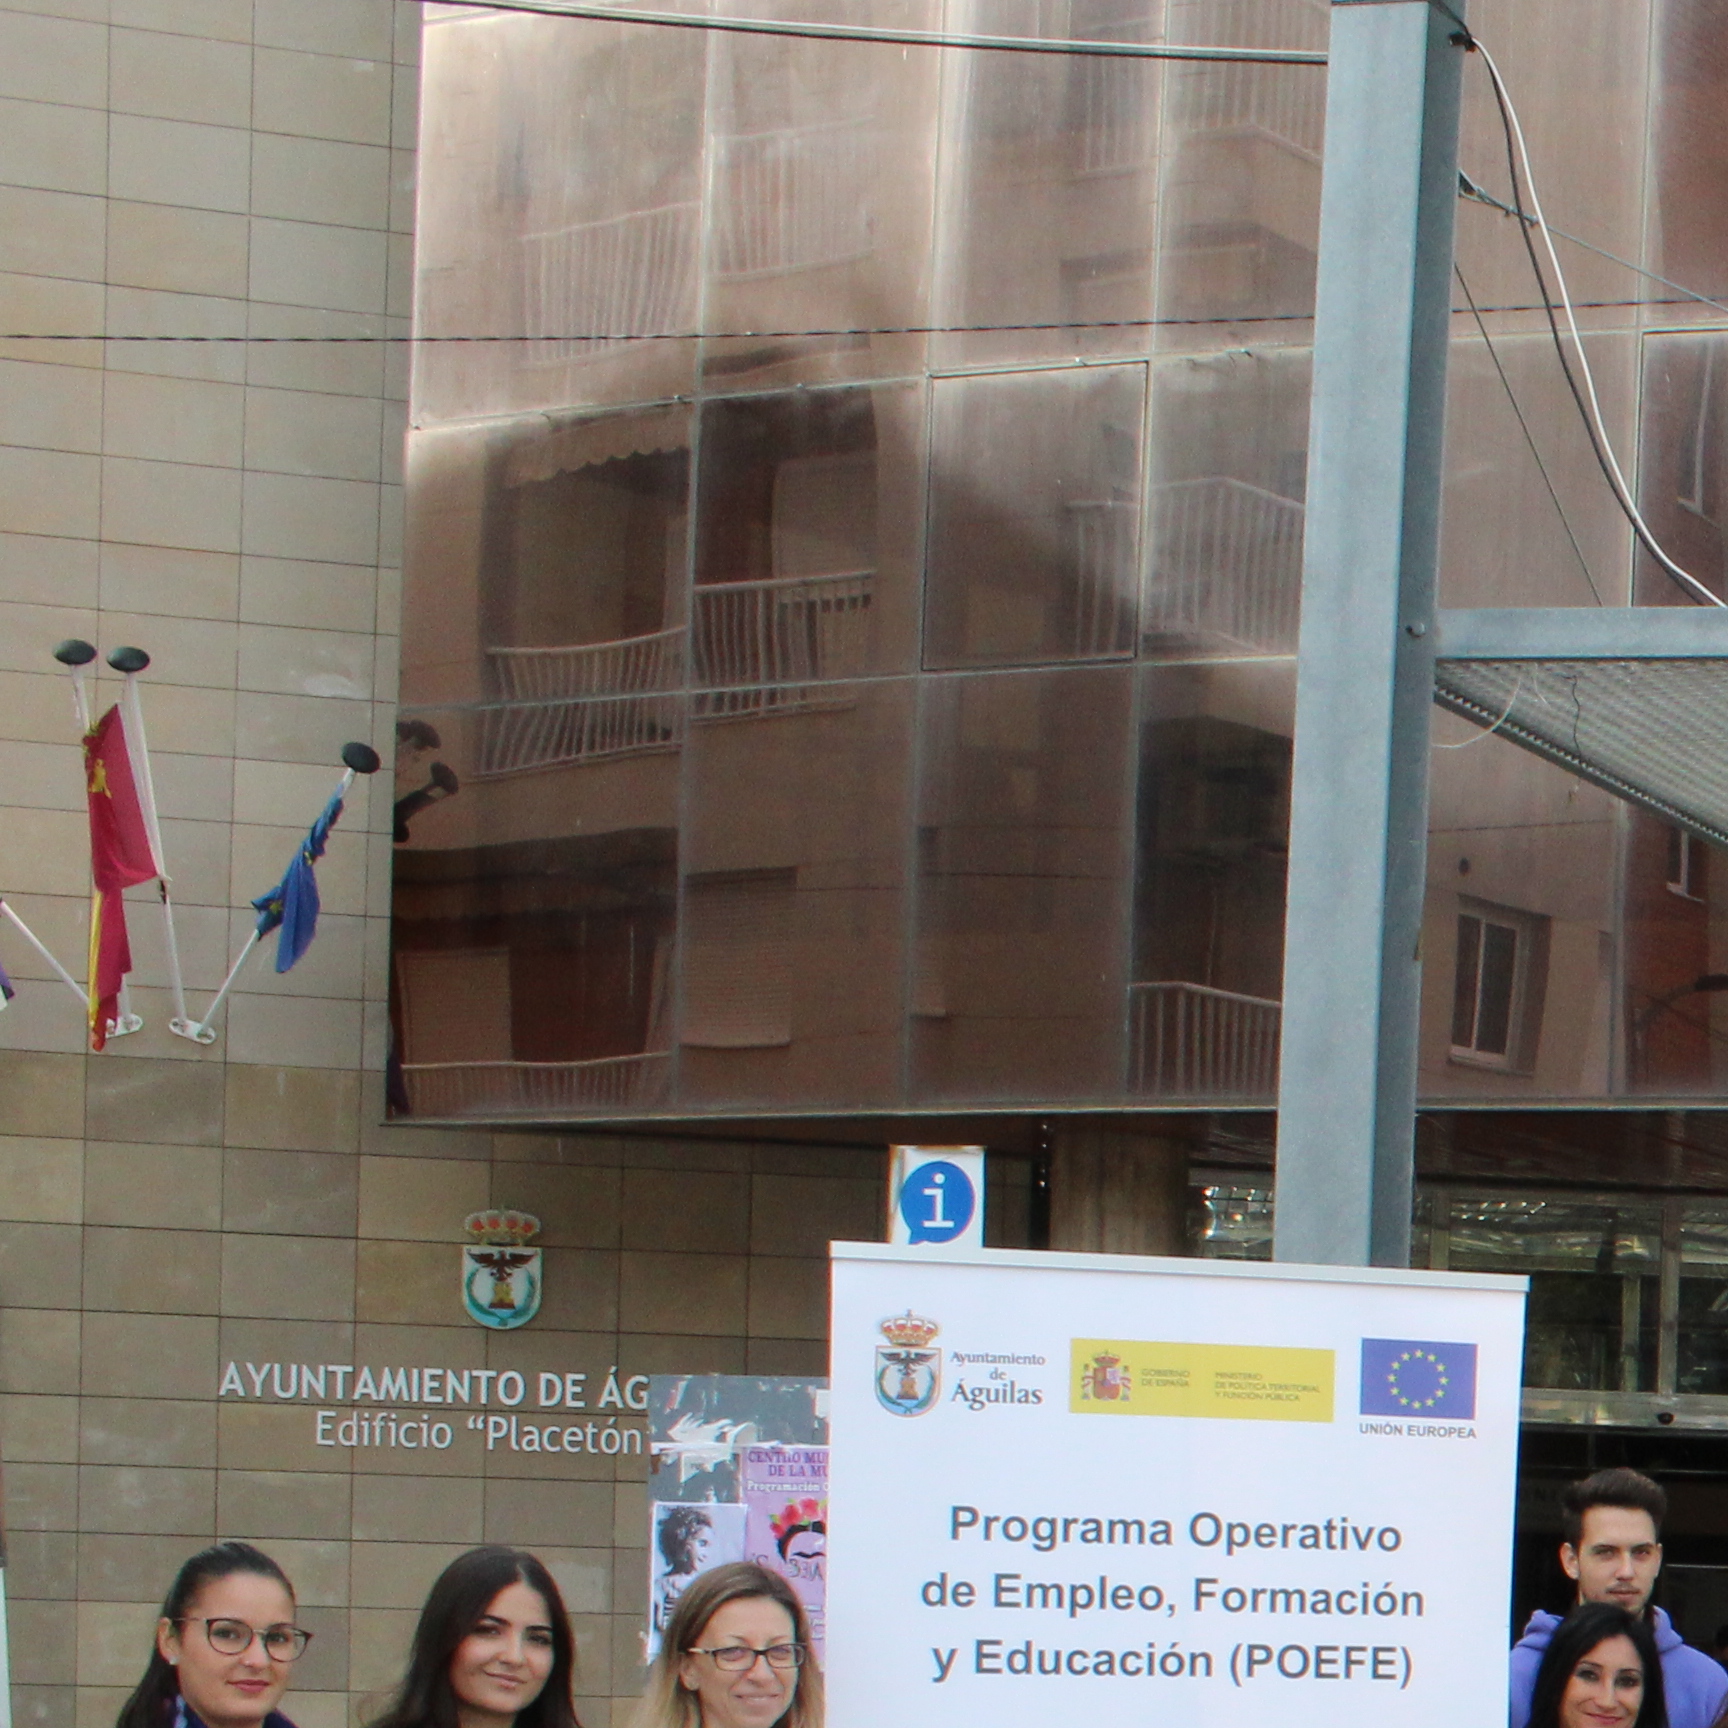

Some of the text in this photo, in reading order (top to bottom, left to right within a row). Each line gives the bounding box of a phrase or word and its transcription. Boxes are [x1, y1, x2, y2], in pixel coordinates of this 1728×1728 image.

[950, 1351, 1047, 1367] Ayuntamiento
[989, 1367, 1007, 1381] de
[1141, 1368, 1190, 1378] GOBIERNO
[218, 1362, 649, 1410] AYUNTAMIENTO DE ÁG
[951, 1378, 1044, 1412] Águilas
[316, 1411, 643, 1455] Edificio “Placetón
[1359, 1421, 1477, 1440] UNIÓN EUROPEA
[768, 1464, 786, 1477] DE
[789, 1464, 806, 1477] LA
[950, 1506, 1403, 1556] Programa Operativo
[921, 1573, 1425, 1618] de Empleo, Formación
[931, 1639, 1413, 1689] y Educación (POEFE)
